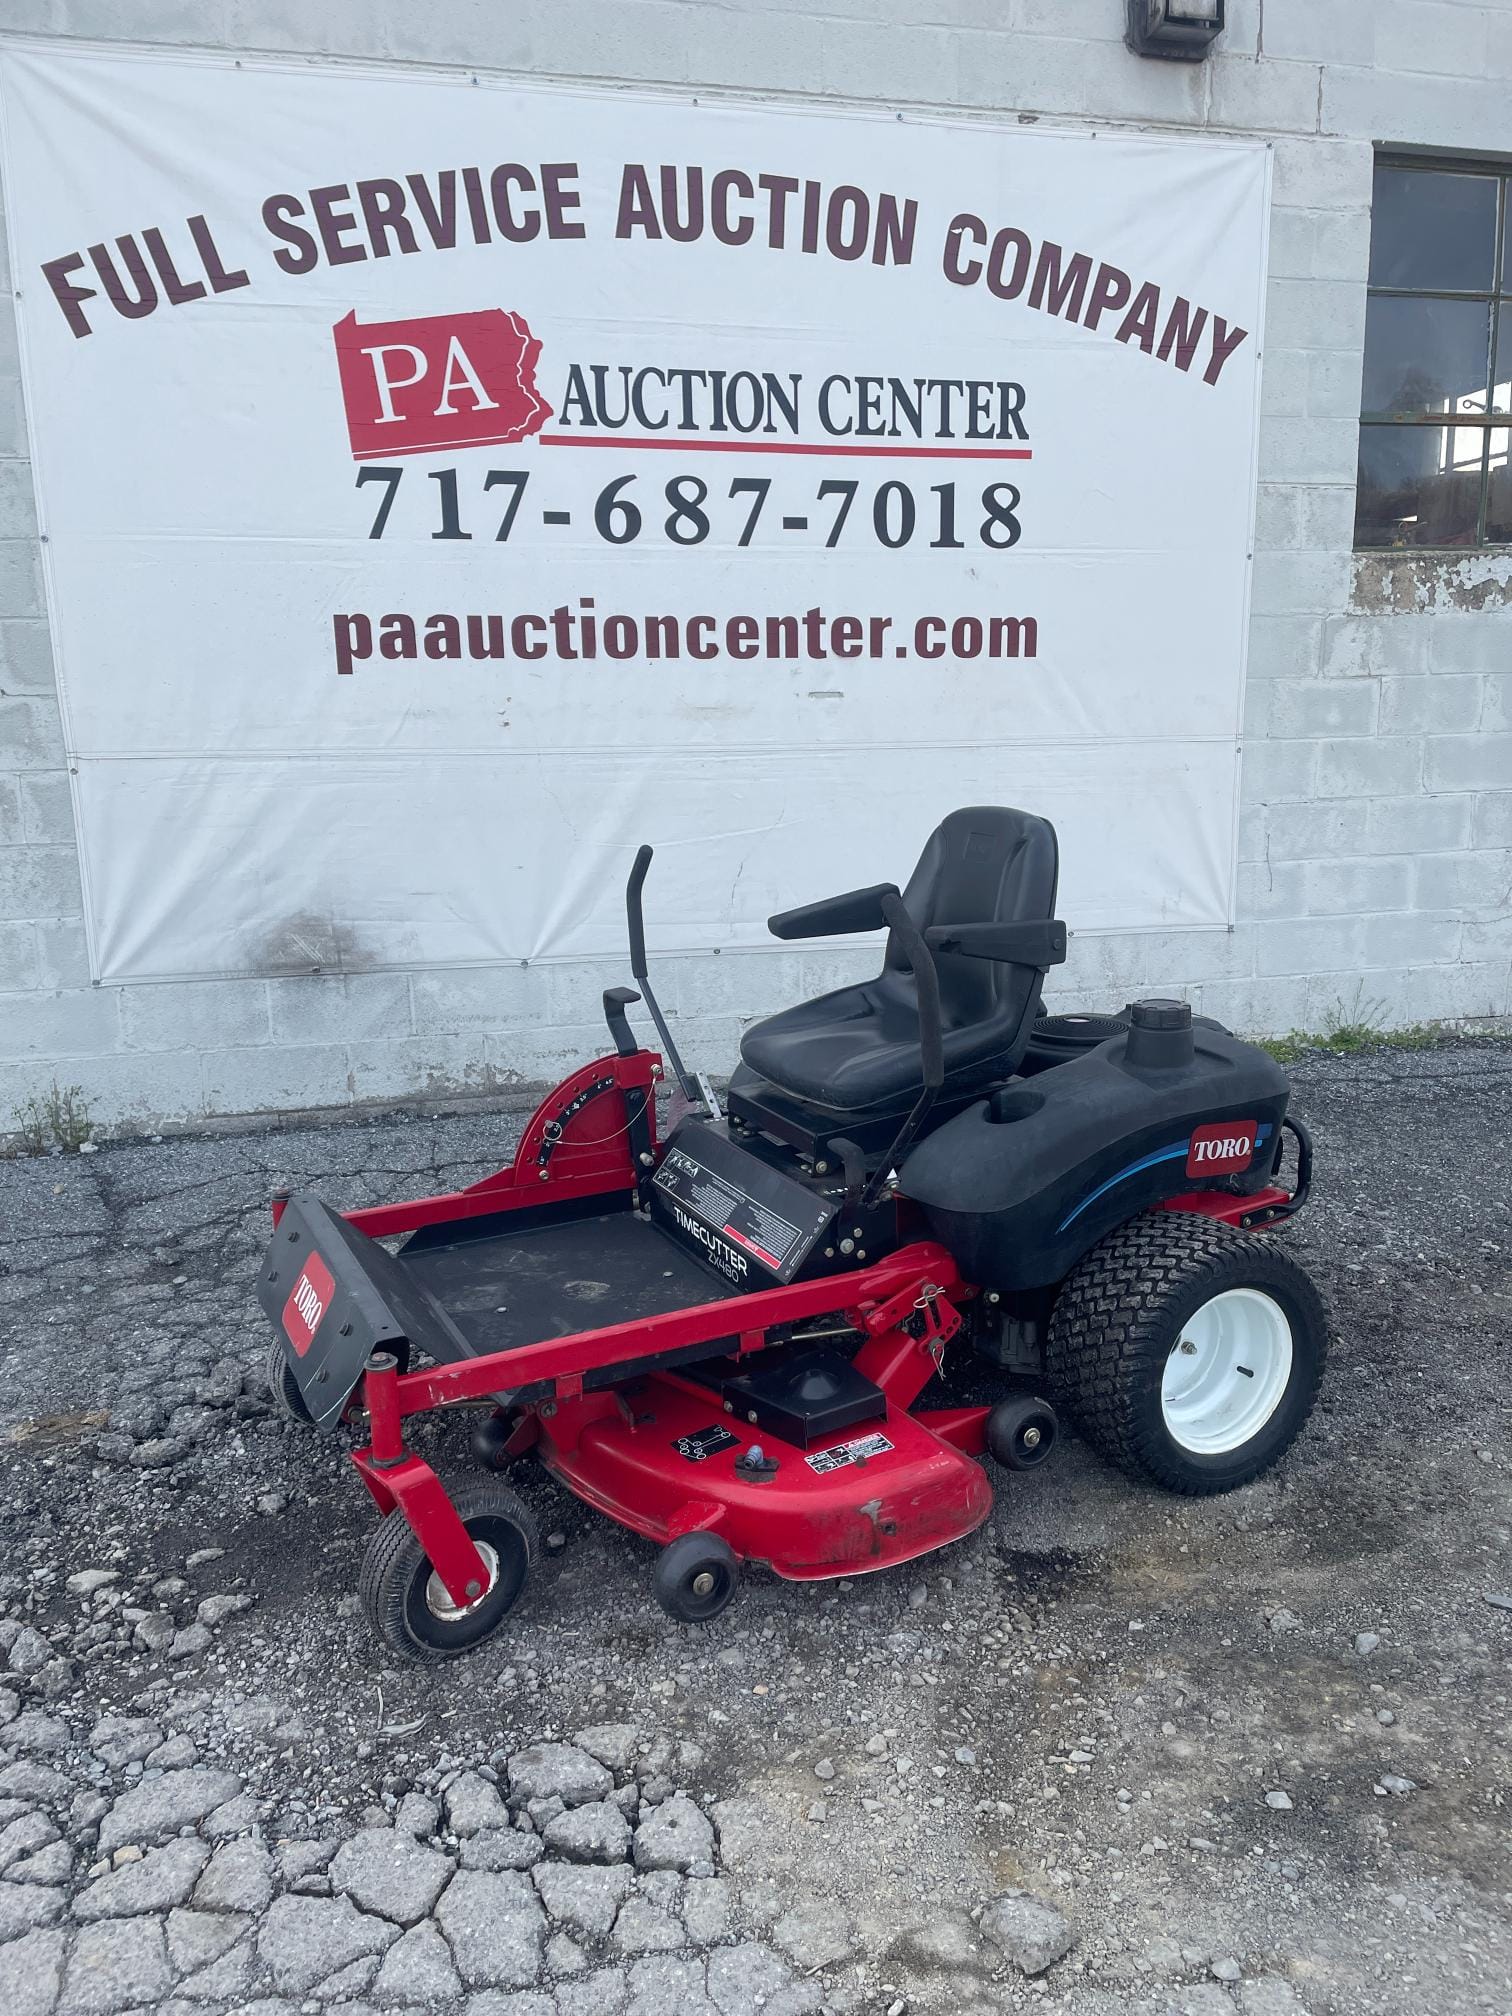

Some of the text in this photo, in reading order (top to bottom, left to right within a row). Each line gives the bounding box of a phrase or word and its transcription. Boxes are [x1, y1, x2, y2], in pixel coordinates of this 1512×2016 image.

[40, 162, 1249, 387] FULL SERVICE AUCTION COMPANY
[360, 336, 1030, 441] PA AUCTION CENTER
[354, 465, 1023, 549] 717-687-7018
[332, 597, 1039, 675] paauctioncenter.com
[1194, 1136, 1251, 1162] TORO
[673, 1205, 749, 1277] TIMECUTTER
[707, 1249, 740, 1284] ZX480
[293, 1273, 323, 1331] TORO
